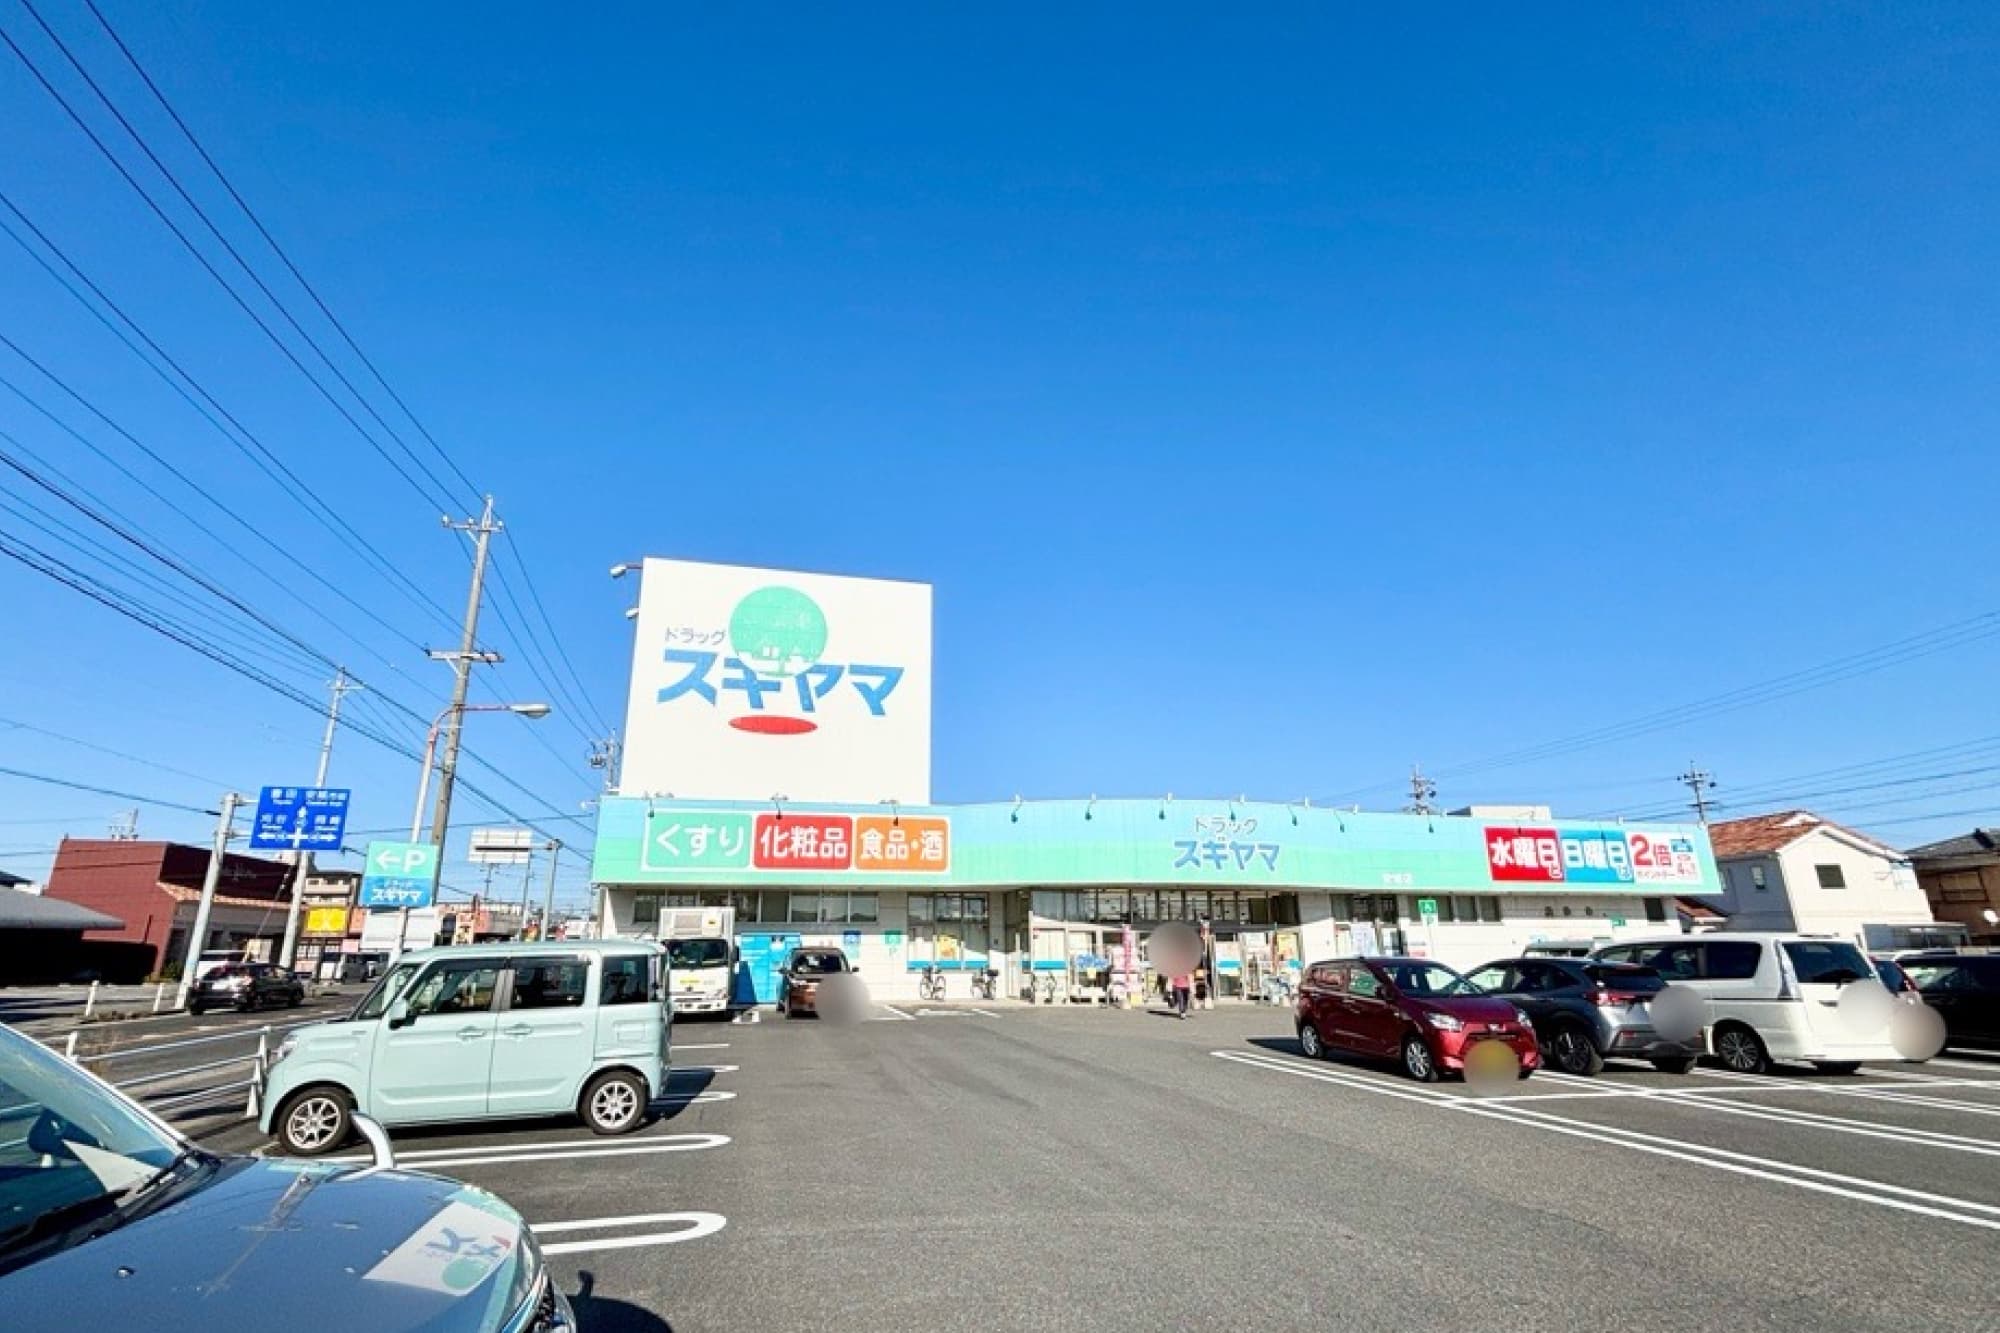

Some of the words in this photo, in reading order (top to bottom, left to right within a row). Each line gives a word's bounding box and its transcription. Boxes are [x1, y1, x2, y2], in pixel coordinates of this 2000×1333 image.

[664, 626, 725, 646] ドラッグ
[656, 646, 905, 716] スギヤマ
[656, 823, 745, 858] くすり
[760, 825, 848, 860] 化粧品
[1173, 836, 1281, 872] スギヤマ
[403, 849, 427, 873] P
